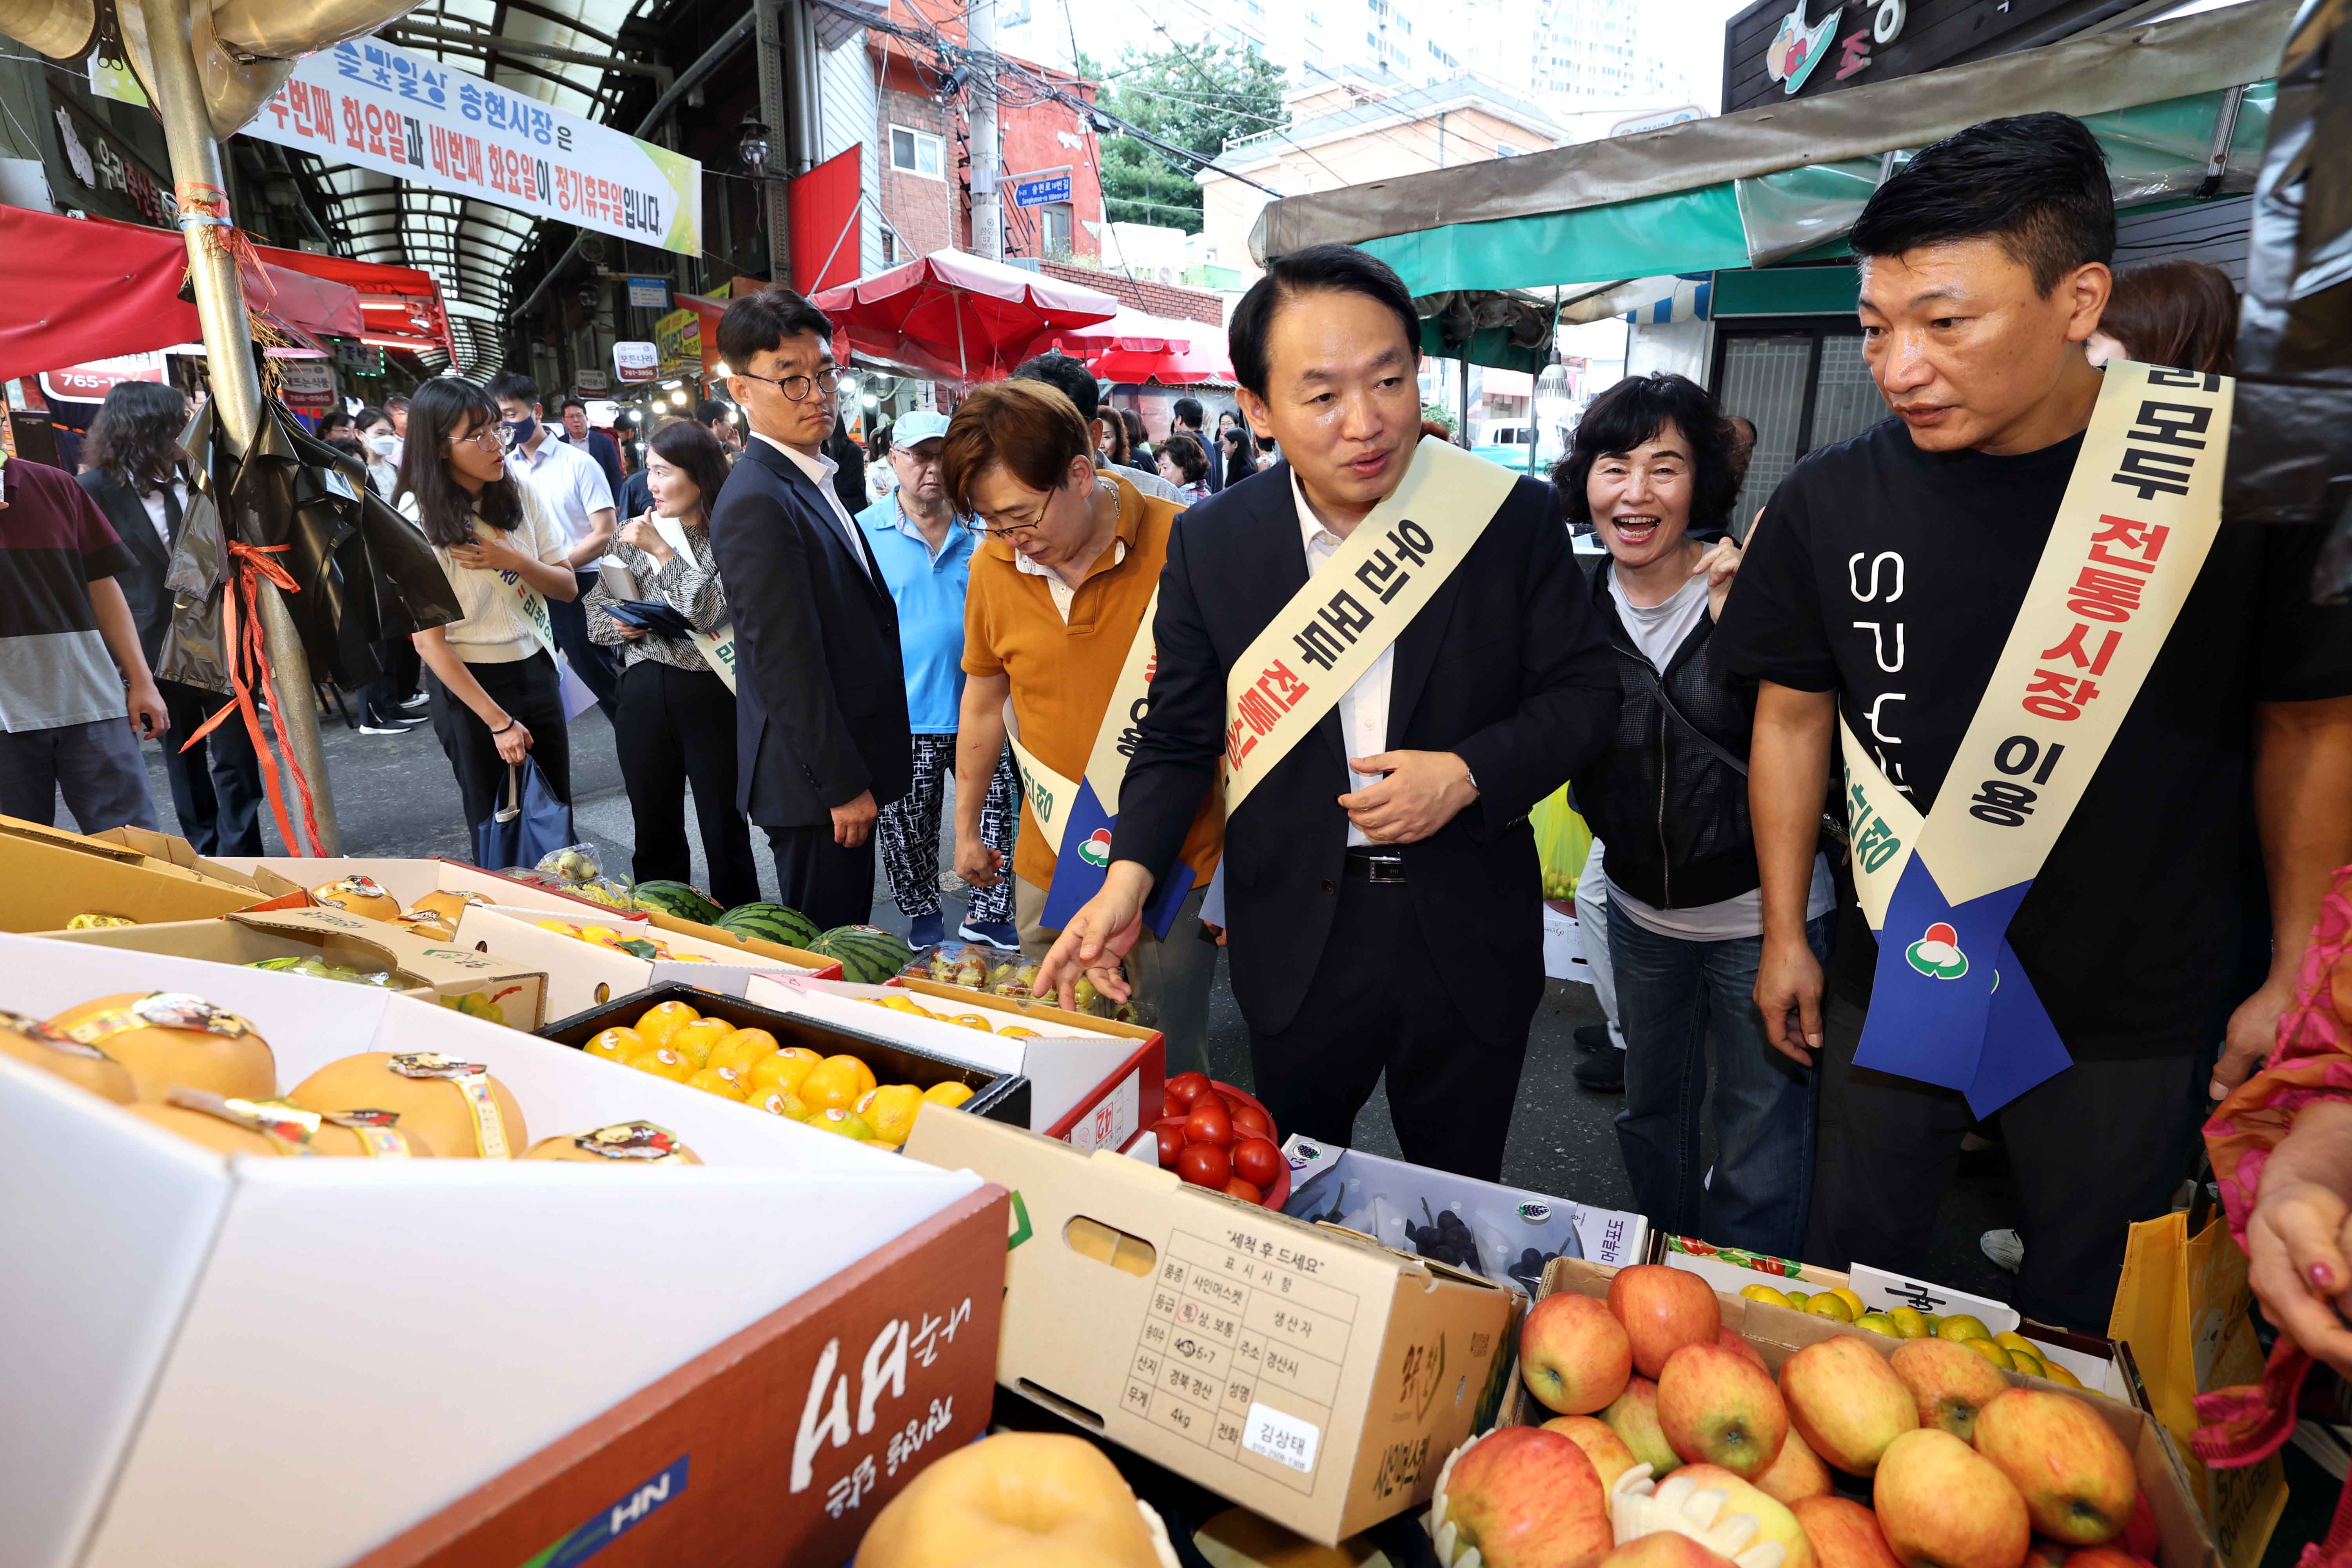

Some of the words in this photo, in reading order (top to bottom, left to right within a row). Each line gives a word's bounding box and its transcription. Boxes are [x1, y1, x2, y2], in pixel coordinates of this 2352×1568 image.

[342, 95, 425, 170] 화요일과
[429, 123, 484, 187] 네번째
[488, 143, 552, 206] 화요일이
[555, 165, 662, 237] 정기휴무일입니다.
[621, 355, 654, 364] 모든나라
[2111, 400, 2213, 501] 모두
[1354, 519, 1434, 605] 우리
[1292, 588, 1375, 671] 모두
[2022, 514, 2171, 722] 전통시장
[1969, 735, 2065, 828] 이용
[1259, 1242, 1274, 1259] 후
[1600, 1219, 1624, 1262] 머루포도
[1137, 1355, 1158, 1376] 산지
[1170, 1369, 1190, 1390] 경북
[1192, 1378, 1212, 1401] 경산
[1240, 1340, 1259, 1361] 주소
[1267, 1352, 1299, 1379] 경산시
[1127, 1386, 1149, 1408] 무게
[1170, 1408, 1191, 1429] 4kg
[1229, 1381, 1250, 1403] 성명
